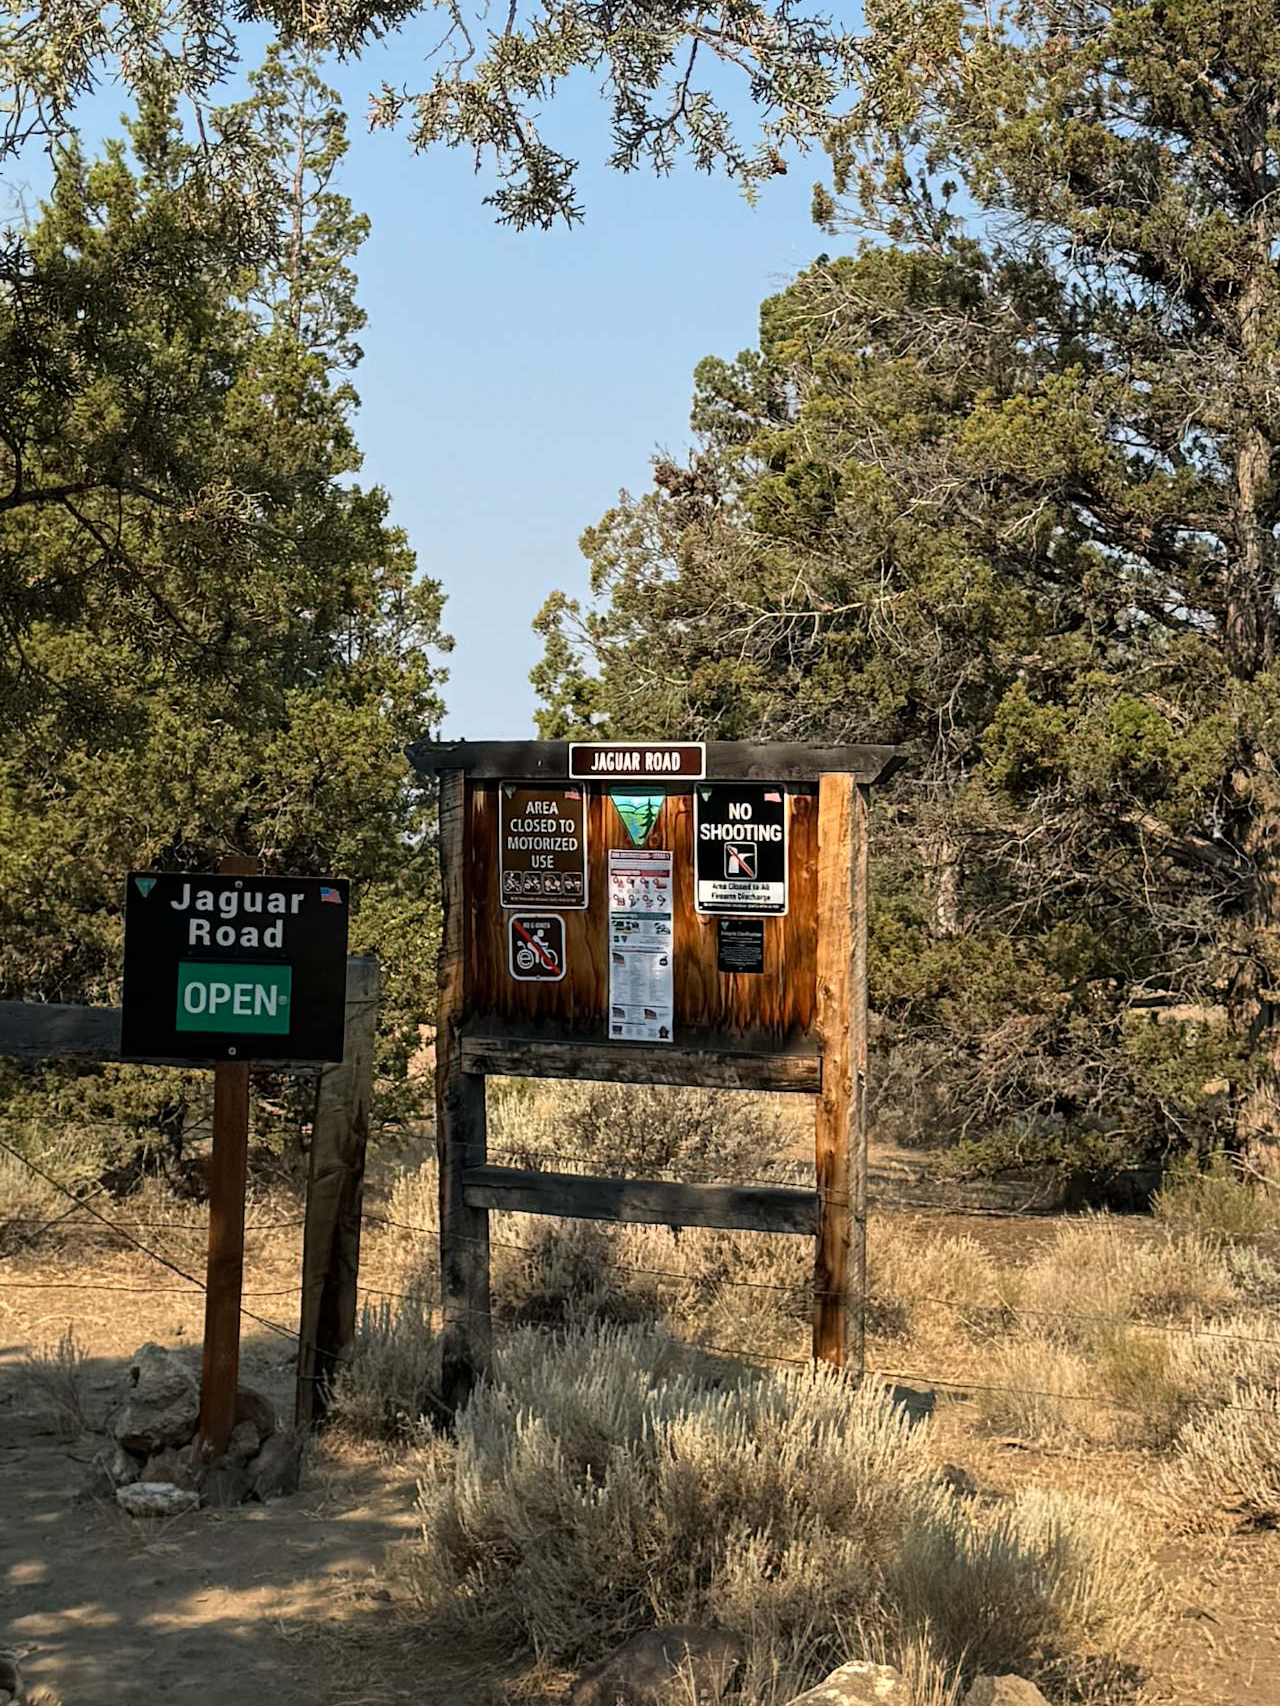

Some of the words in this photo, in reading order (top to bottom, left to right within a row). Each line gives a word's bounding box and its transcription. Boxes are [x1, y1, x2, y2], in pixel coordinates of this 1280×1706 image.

[591, 751, 640, 771] JAGUAR
[645, 751, 681, 771] ROAD
[525, 801, 559, 815] AREA
[728, 802, 753, 820] NO
[510, 818, 557, 833] CLOSED
[559, 819, 575, 833] TO
[700, 823, 782, 842] SHOOTING
[507, 836, 578, 851] MOTORIZED
[531, 855, 554, 868] USE
[170, 883, 305, 920] Jaguar
[188, 918, 284, 948] Road
[184, 981, 278, 1016] OPEN
